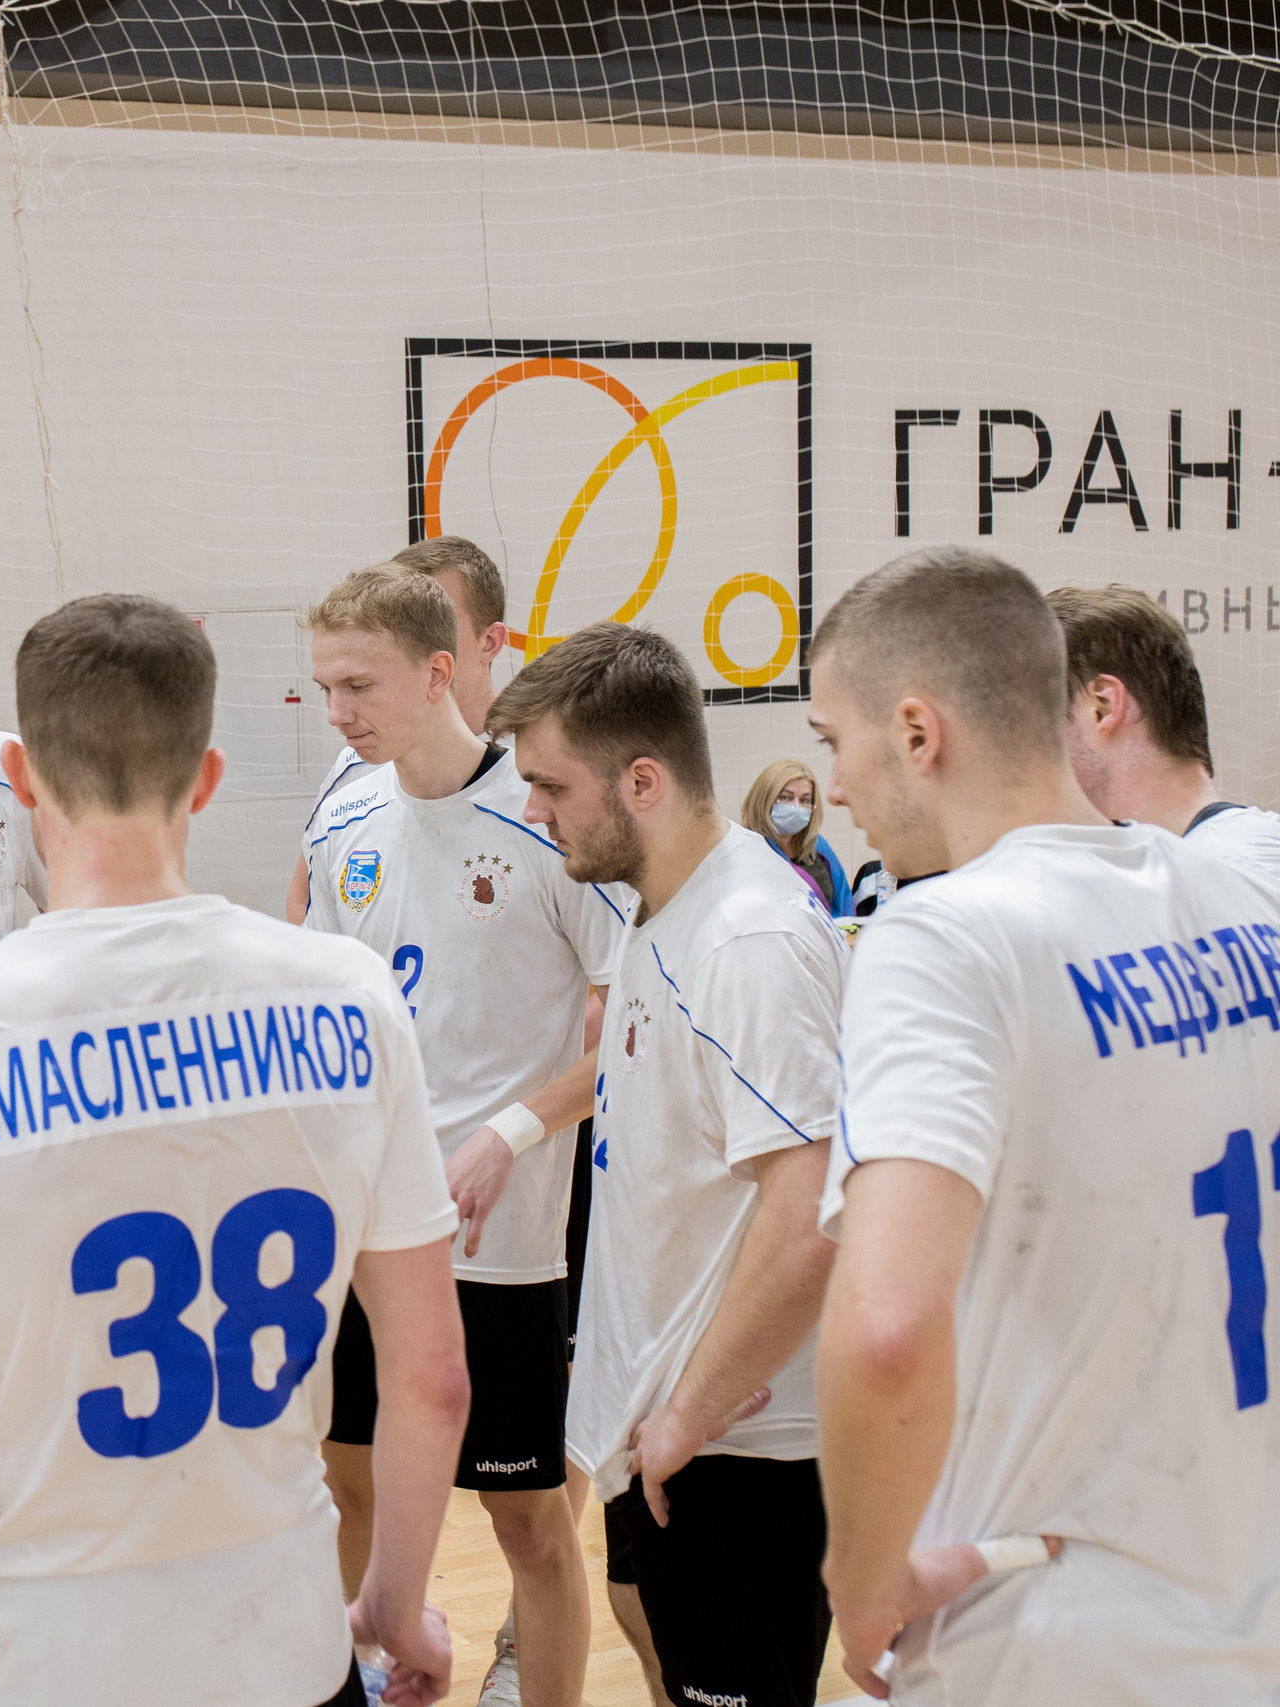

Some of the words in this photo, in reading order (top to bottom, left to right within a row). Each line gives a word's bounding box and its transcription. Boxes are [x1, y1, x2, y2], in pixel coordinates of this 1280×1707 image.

[331, 792, 378, 818] uhlsport
[1192, 1128, 1280, 1411] 1
[71, 1187, 336, 1459] 38
[476, 1457, 538, 1474] uhlsport
[682, 1684, 748, 1707] uhlsport
